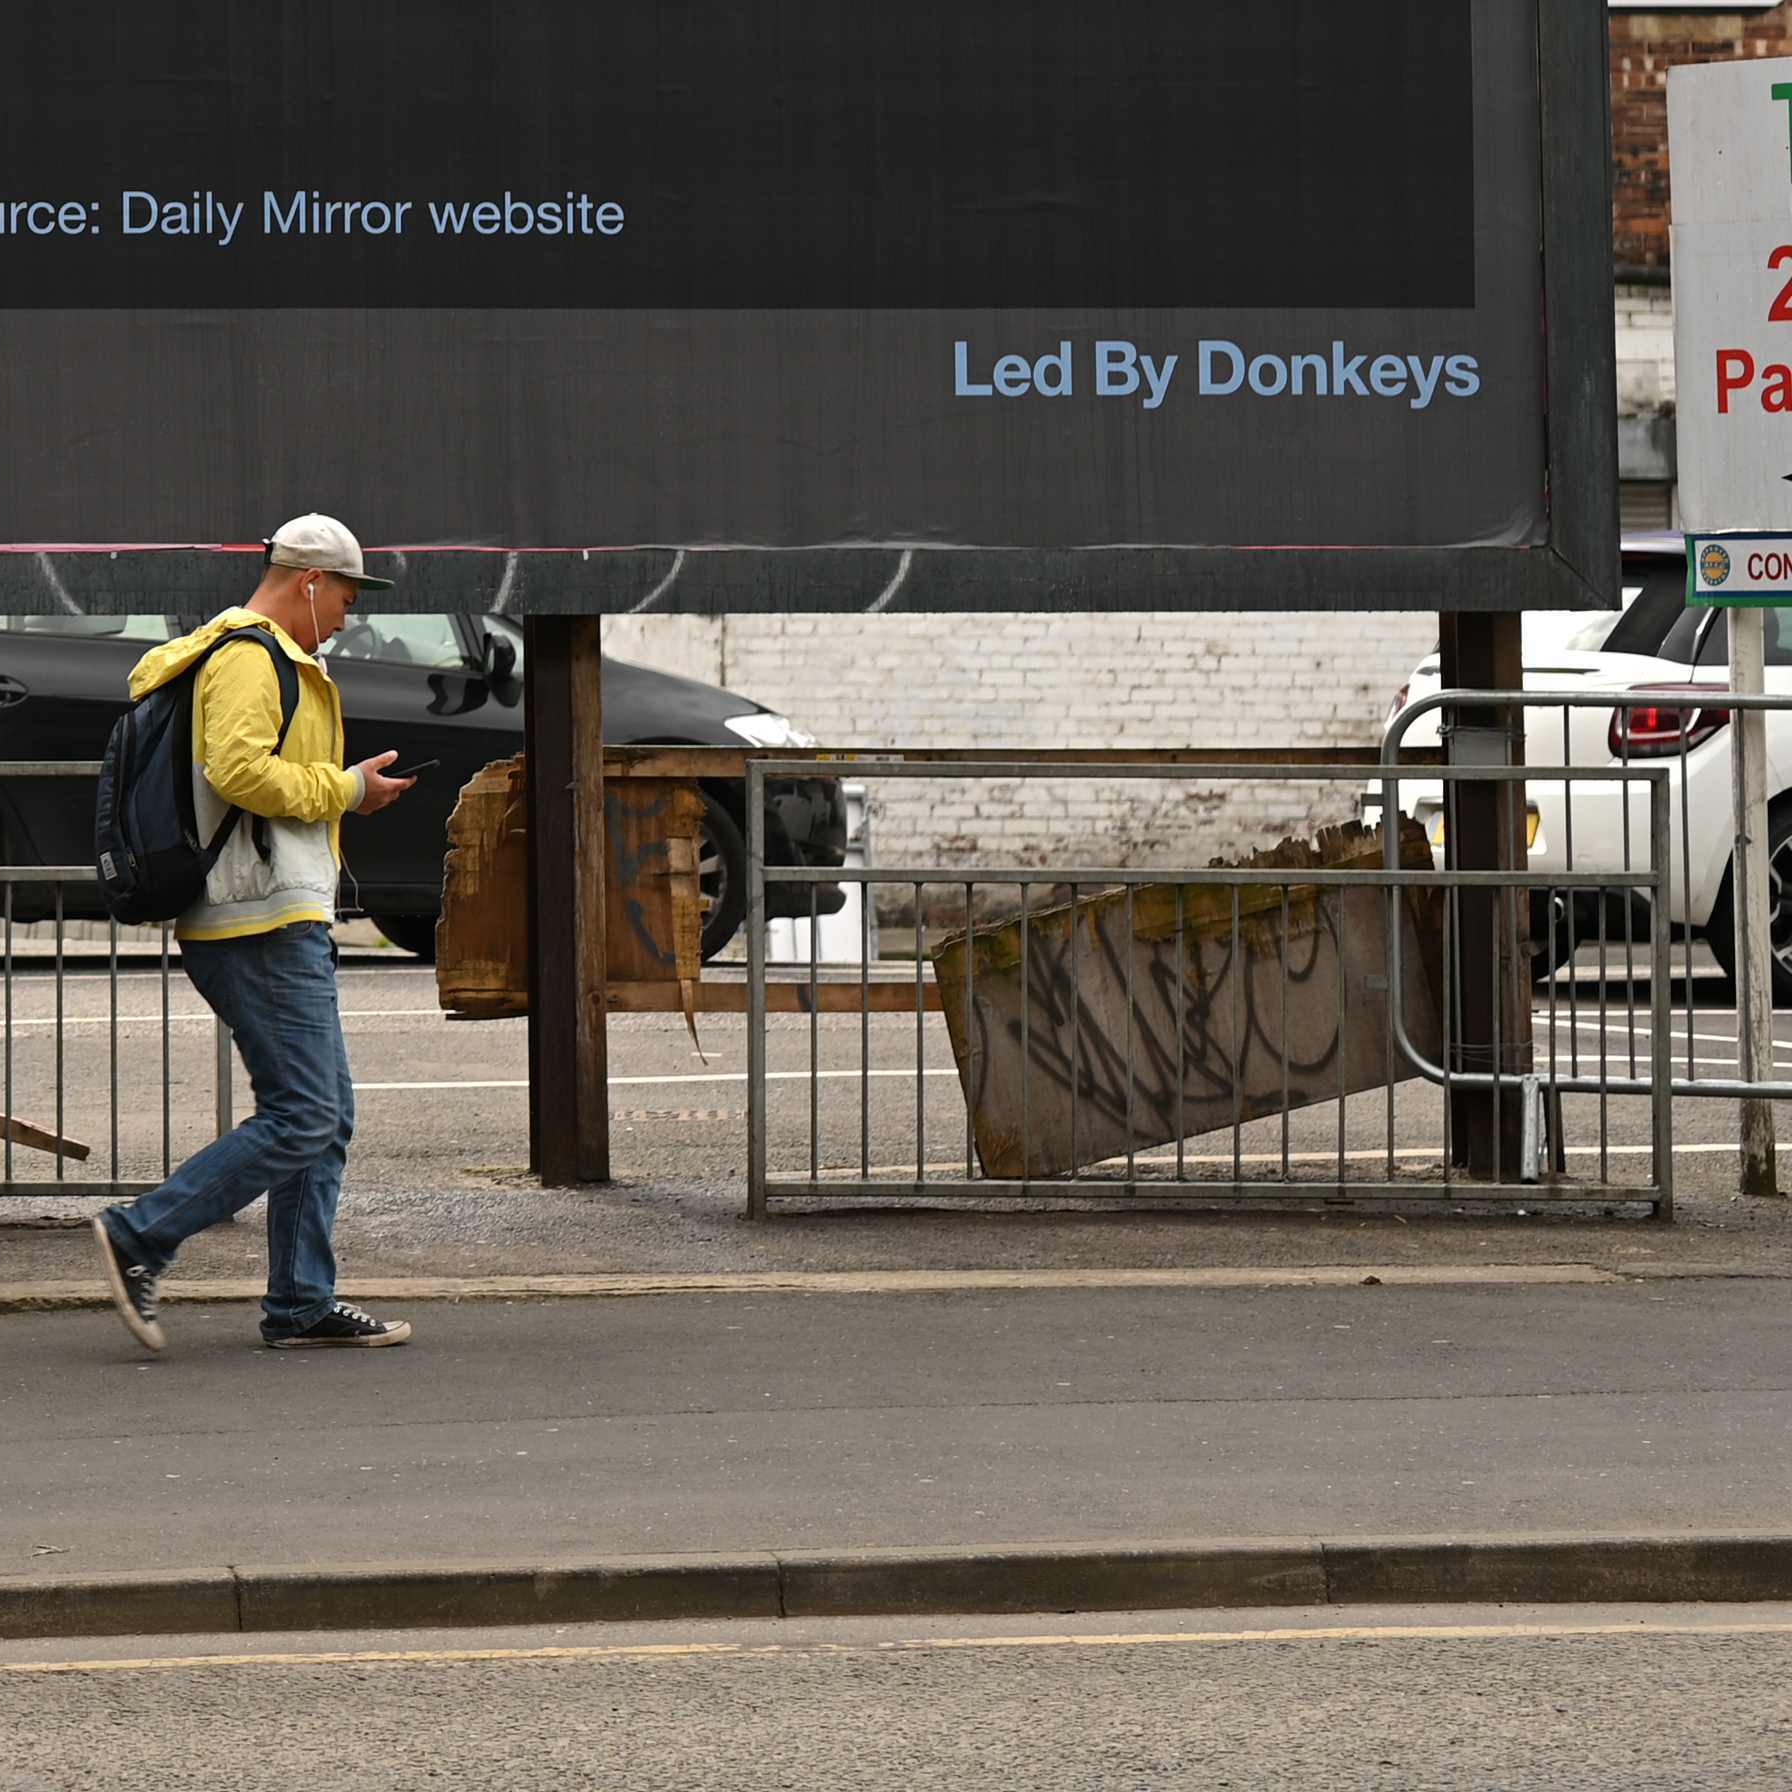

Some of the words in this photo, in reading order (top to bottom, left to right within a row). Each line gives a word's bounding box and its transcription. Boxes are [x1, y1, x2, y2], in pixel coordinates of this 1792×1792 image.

[122, 191, 244, 247] Daily
[263, 190, 414, 235] Mirror
[428, 191, 626, 236] website
[954, 340, 1074, 397] Led
[1095, 340, 1180, 409] By
[1198, 340, 1481, 409] Donkeys
